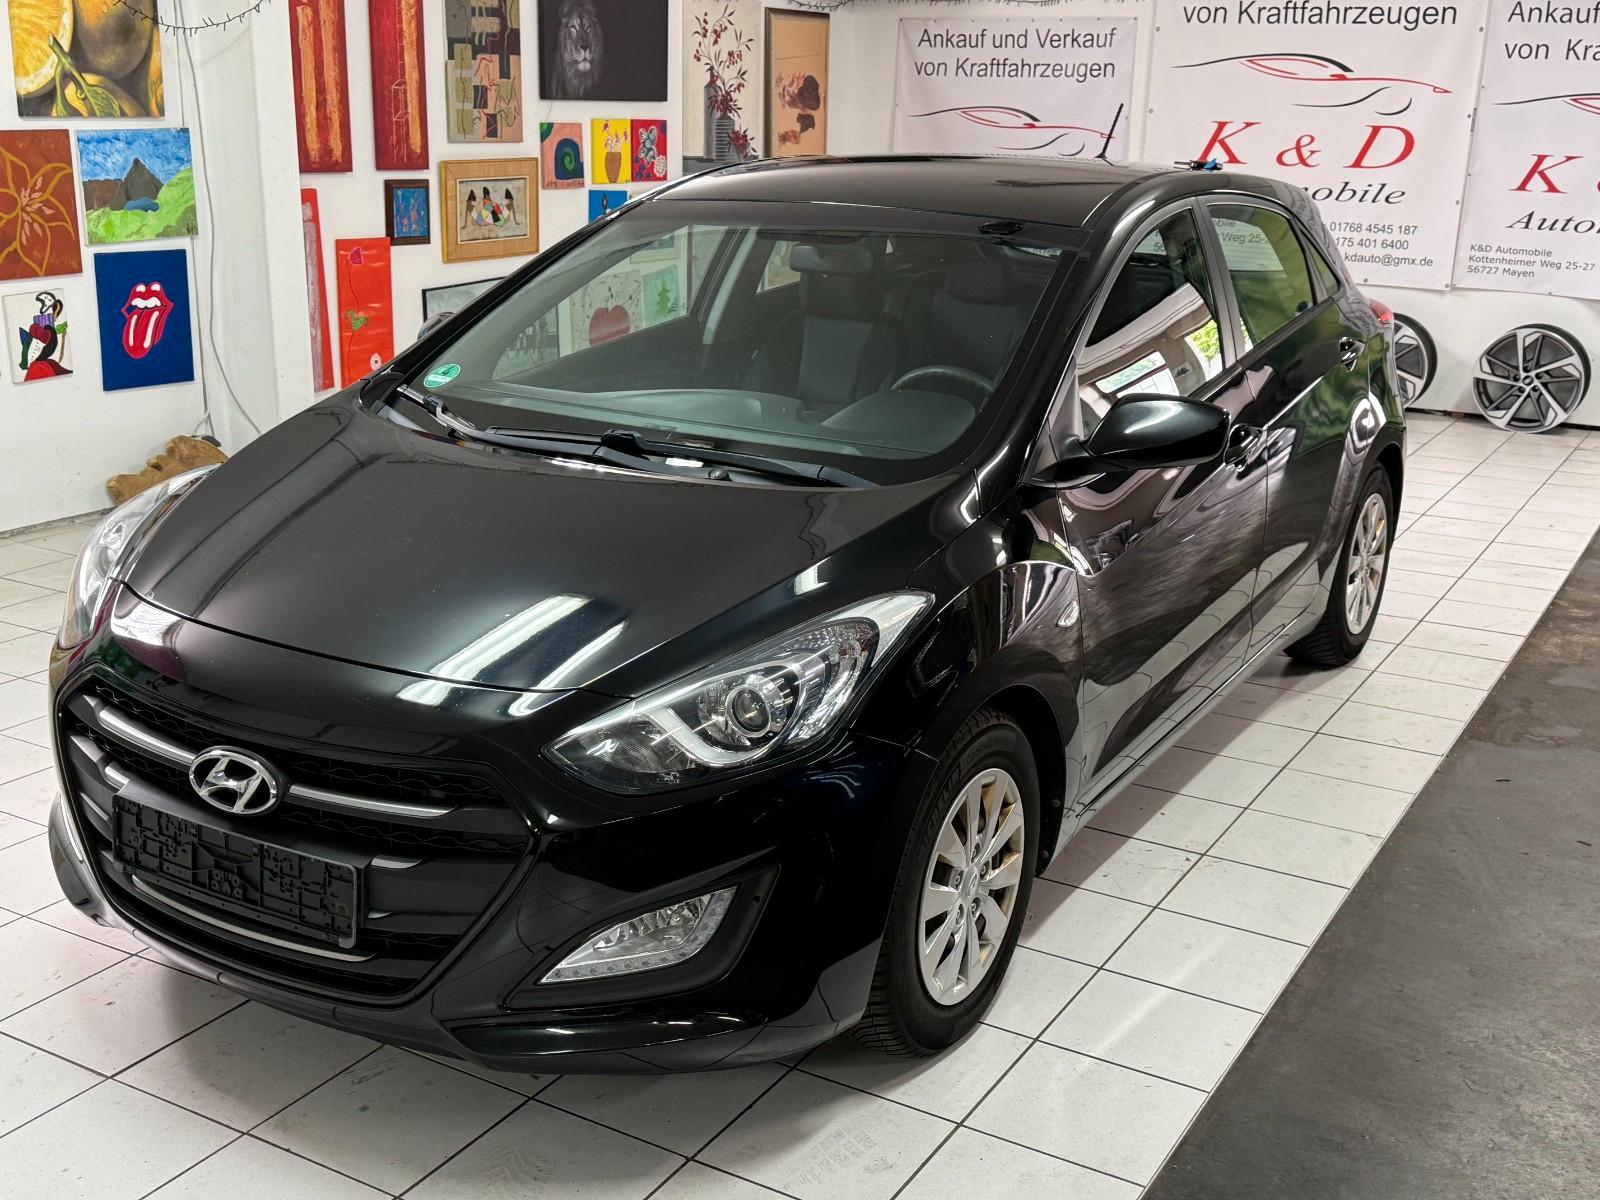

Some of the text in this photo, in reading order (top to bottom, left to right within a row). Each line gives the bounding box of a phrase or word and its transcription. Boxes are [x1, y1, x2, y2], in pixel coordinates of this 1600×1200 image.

[1183, 0, 1457, 30] von Kraftfahrzeugen
[1508, 1, 1600, 24] Ankauf
[918, 27, 1117, 49] Ankauf und Verkauf
[1505, 42, 1550, 60] von
[914, 57, 1115, 83] von Kraftfahrzeugen
[1197, 121, 1415, 170] K & D
[1509, 153, 1584, 194] K
[1330, 222, 1418, 236] 01768 4545 187
[1506, 210, 1600, 234] Auto
[1357, 238, 1377, 249] 401
[1381, 239, 1409, 250] 6400
[1496, 246, 1553, 258] Automobile
[1344, 252, 1434, 268] kdauto@gmx.de
[1468, 255, 1596, 271] Kottenheimer Weg 25-27
[1467, 265, 1535, 278] 56727 Mayen
